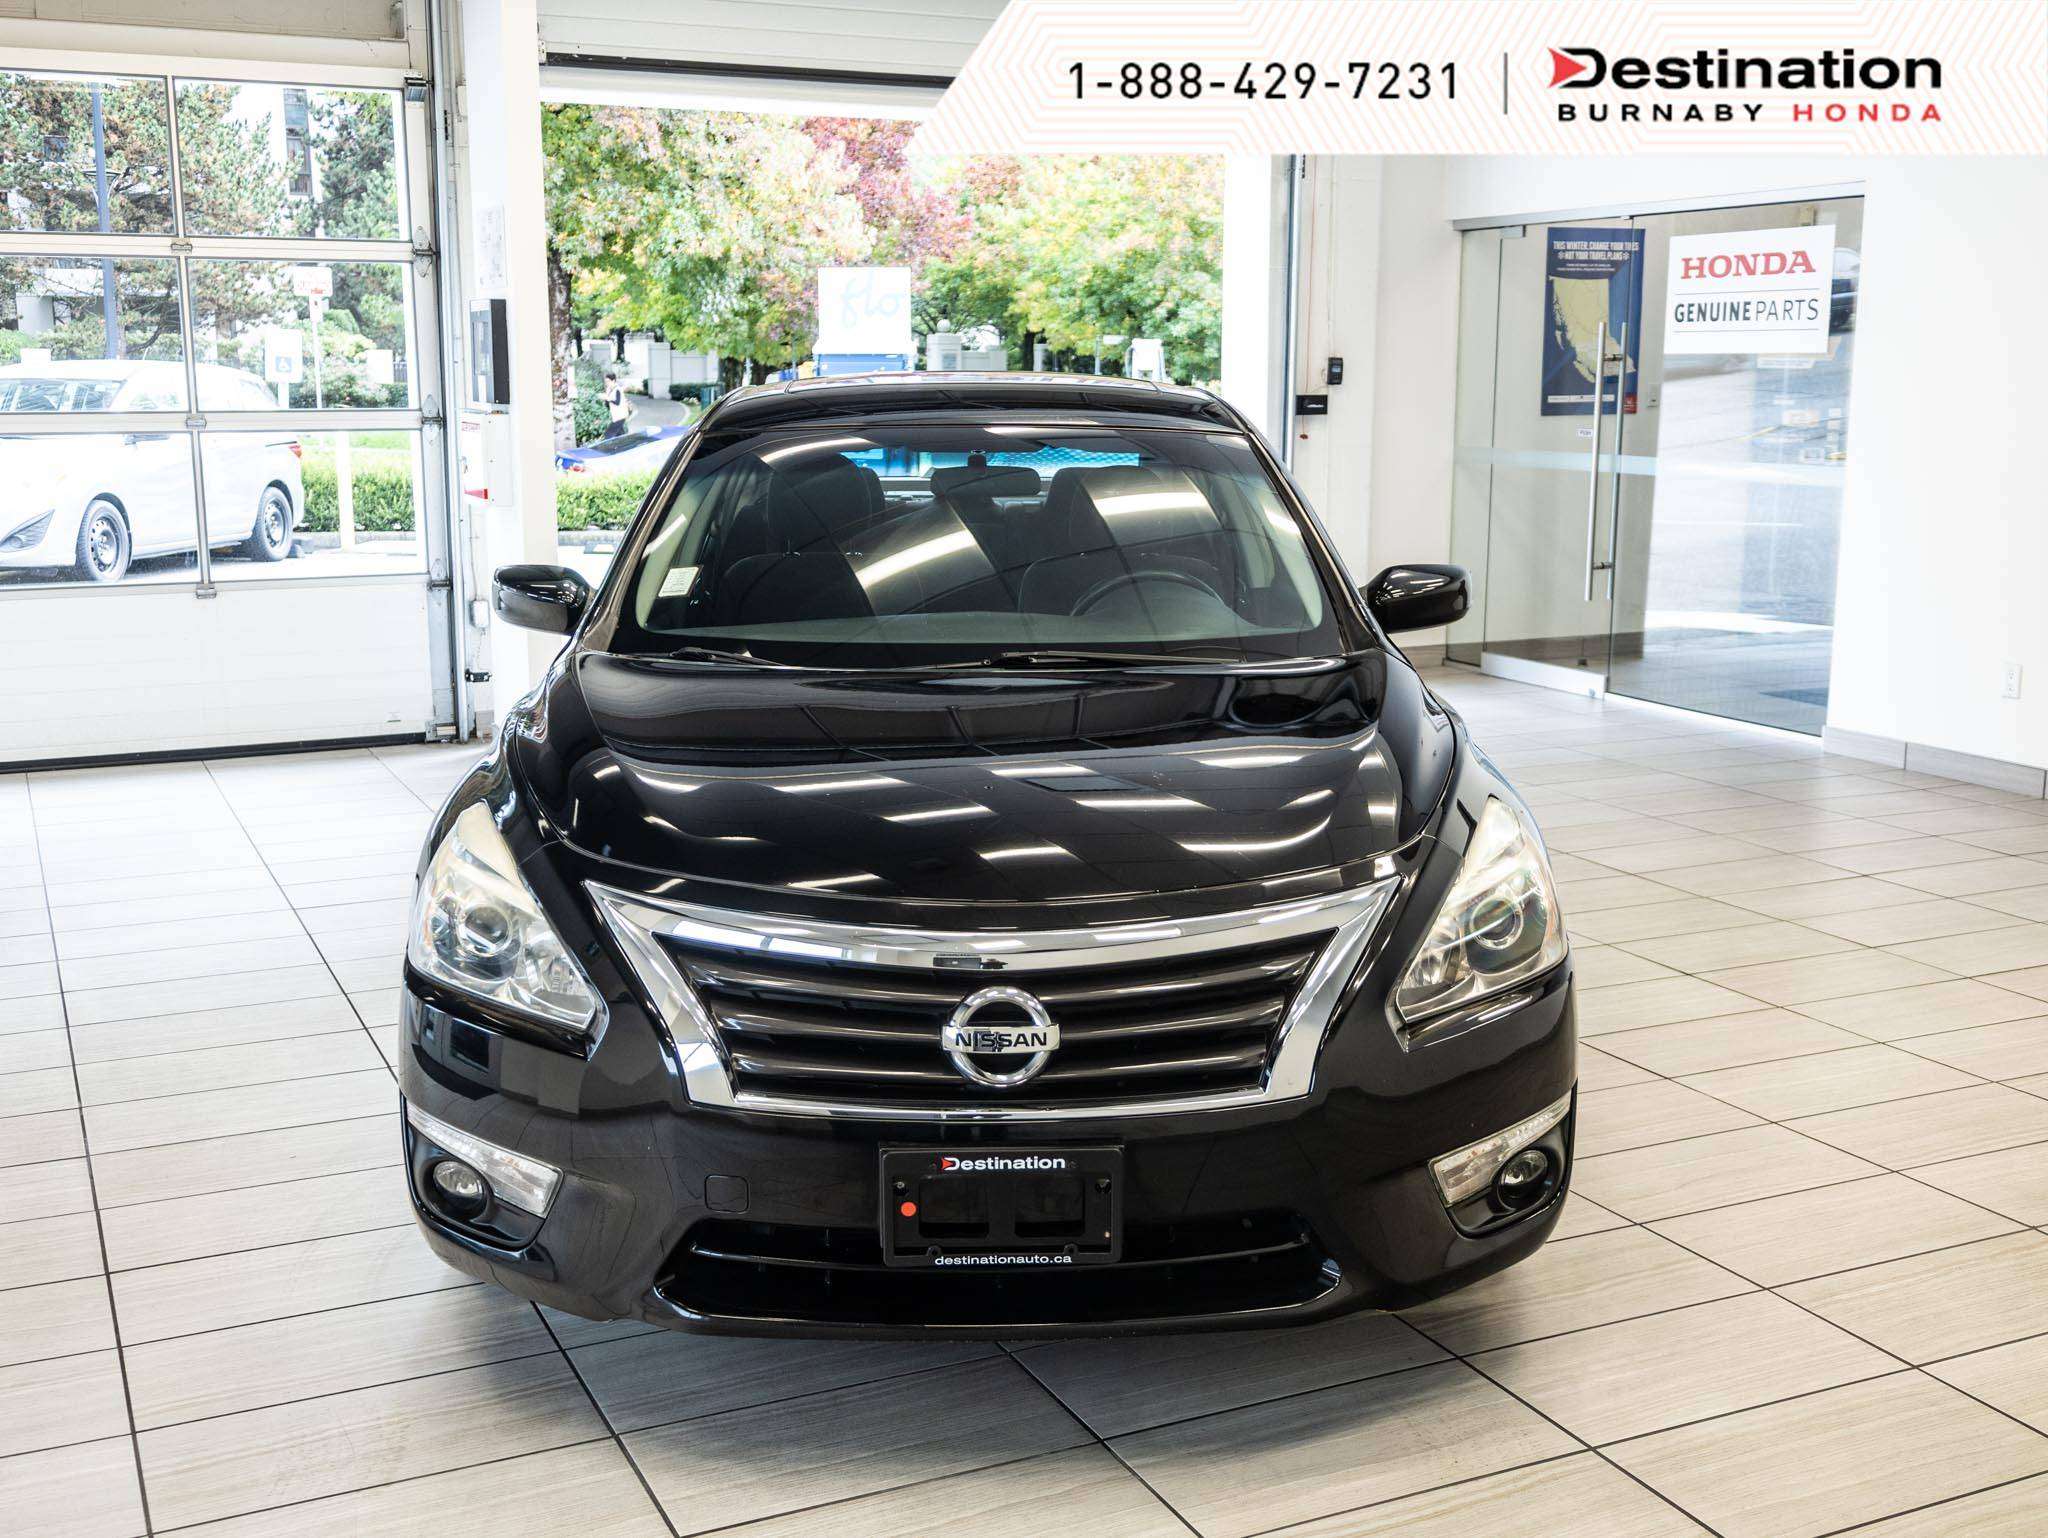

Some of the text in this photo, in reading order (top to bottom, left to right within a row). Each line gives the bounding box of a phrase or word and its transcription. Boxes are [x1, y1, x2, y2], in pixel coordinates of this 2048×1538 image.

[1681, 250, 1817, 279] HONDA
[840, 269, 904, 330] flo
[1674, 298, 1819, 323] GENUINE PARTS
[955, 1031, 1047, 1048] NISSAN
[941, 1156, 1066, 1171] Destination
[934, 1254, 1073, 1266] destinationauto.ca
